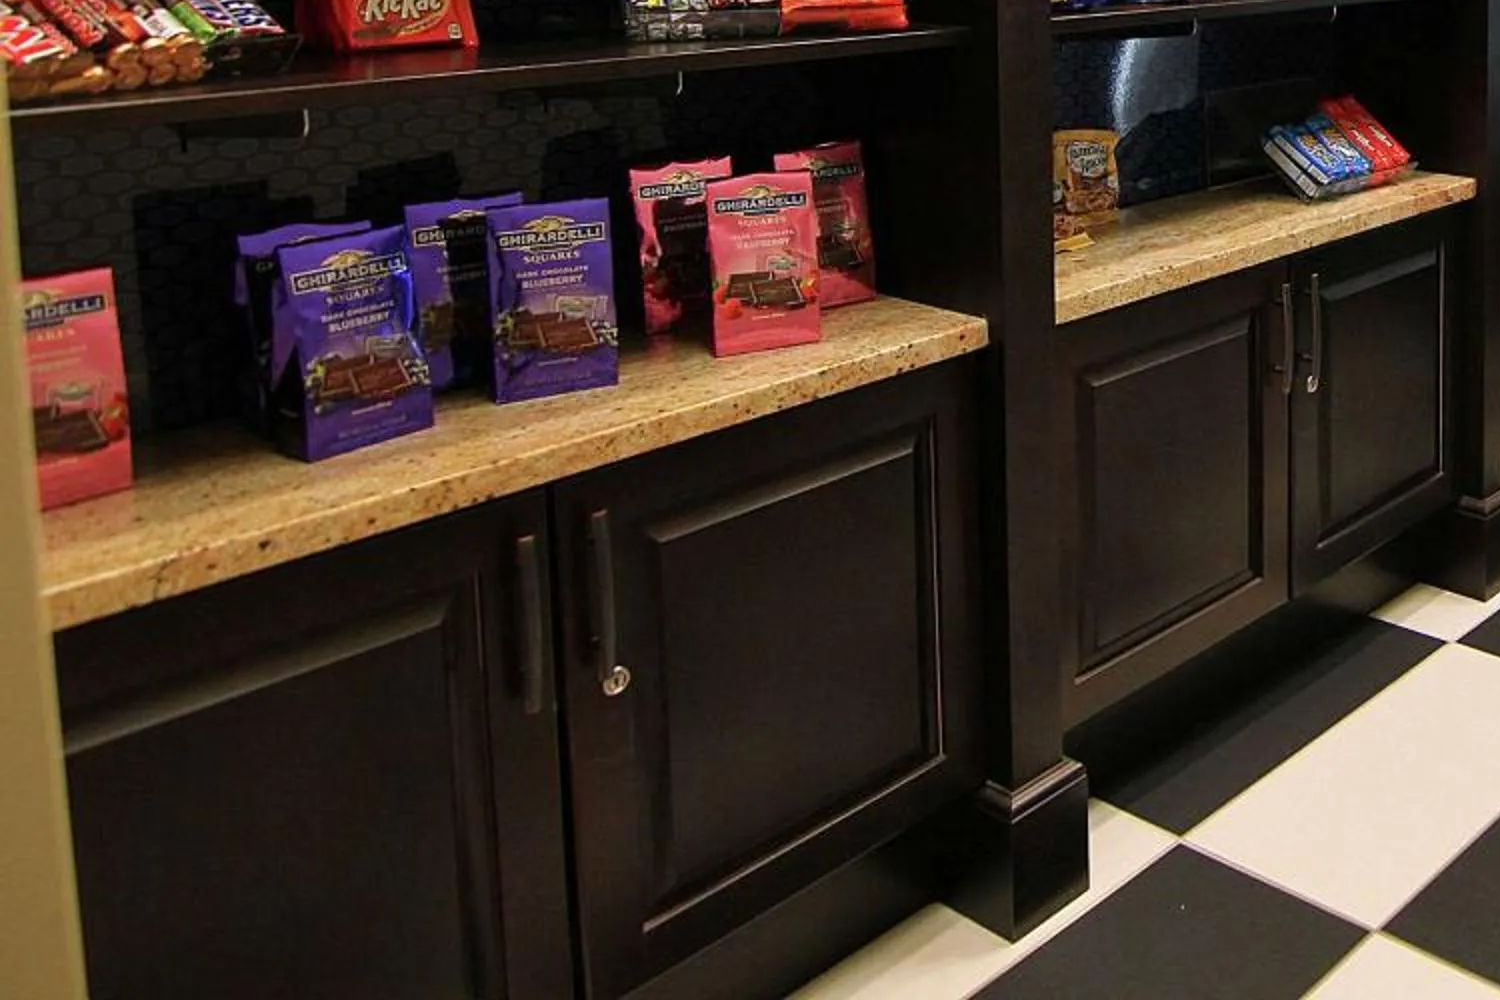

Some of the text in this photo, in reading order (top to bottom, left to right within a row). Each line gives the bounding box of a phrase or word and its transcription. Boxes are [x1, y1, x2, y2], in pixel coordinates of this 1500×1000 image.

[499, 227, 600, 247] GHIRARDELLI
[523, 250, 581, 265] SQUARES
[296, 257, 402, 289] GHIRARDELLI
[522, 274, 583, 289] BLUEBERRY
[328, 311, 390, 333] BLUEBERRY
